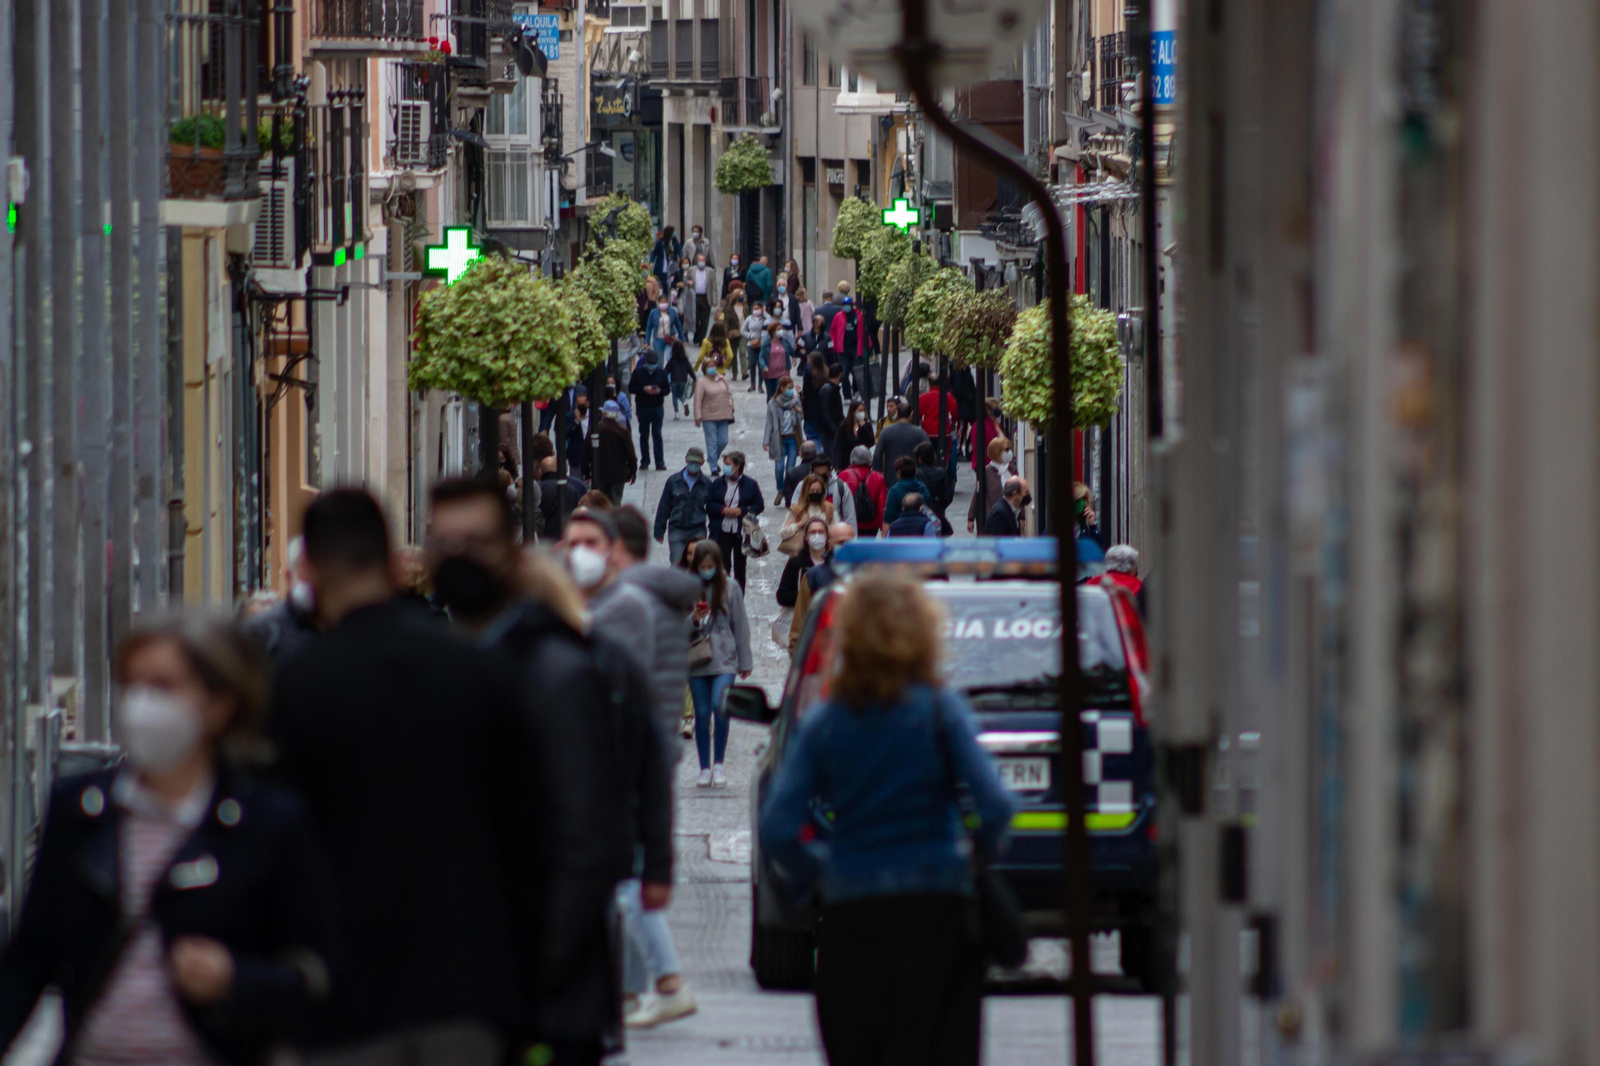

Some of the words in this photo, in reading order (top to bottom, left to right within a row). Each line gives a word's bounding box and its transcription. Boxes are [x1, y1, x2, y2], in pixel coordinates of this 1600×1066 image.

[525, 16, 558, 28] ALQUILA
[549, 45, 558, 58] 81
[1163, 75, 1177, 98] 89
